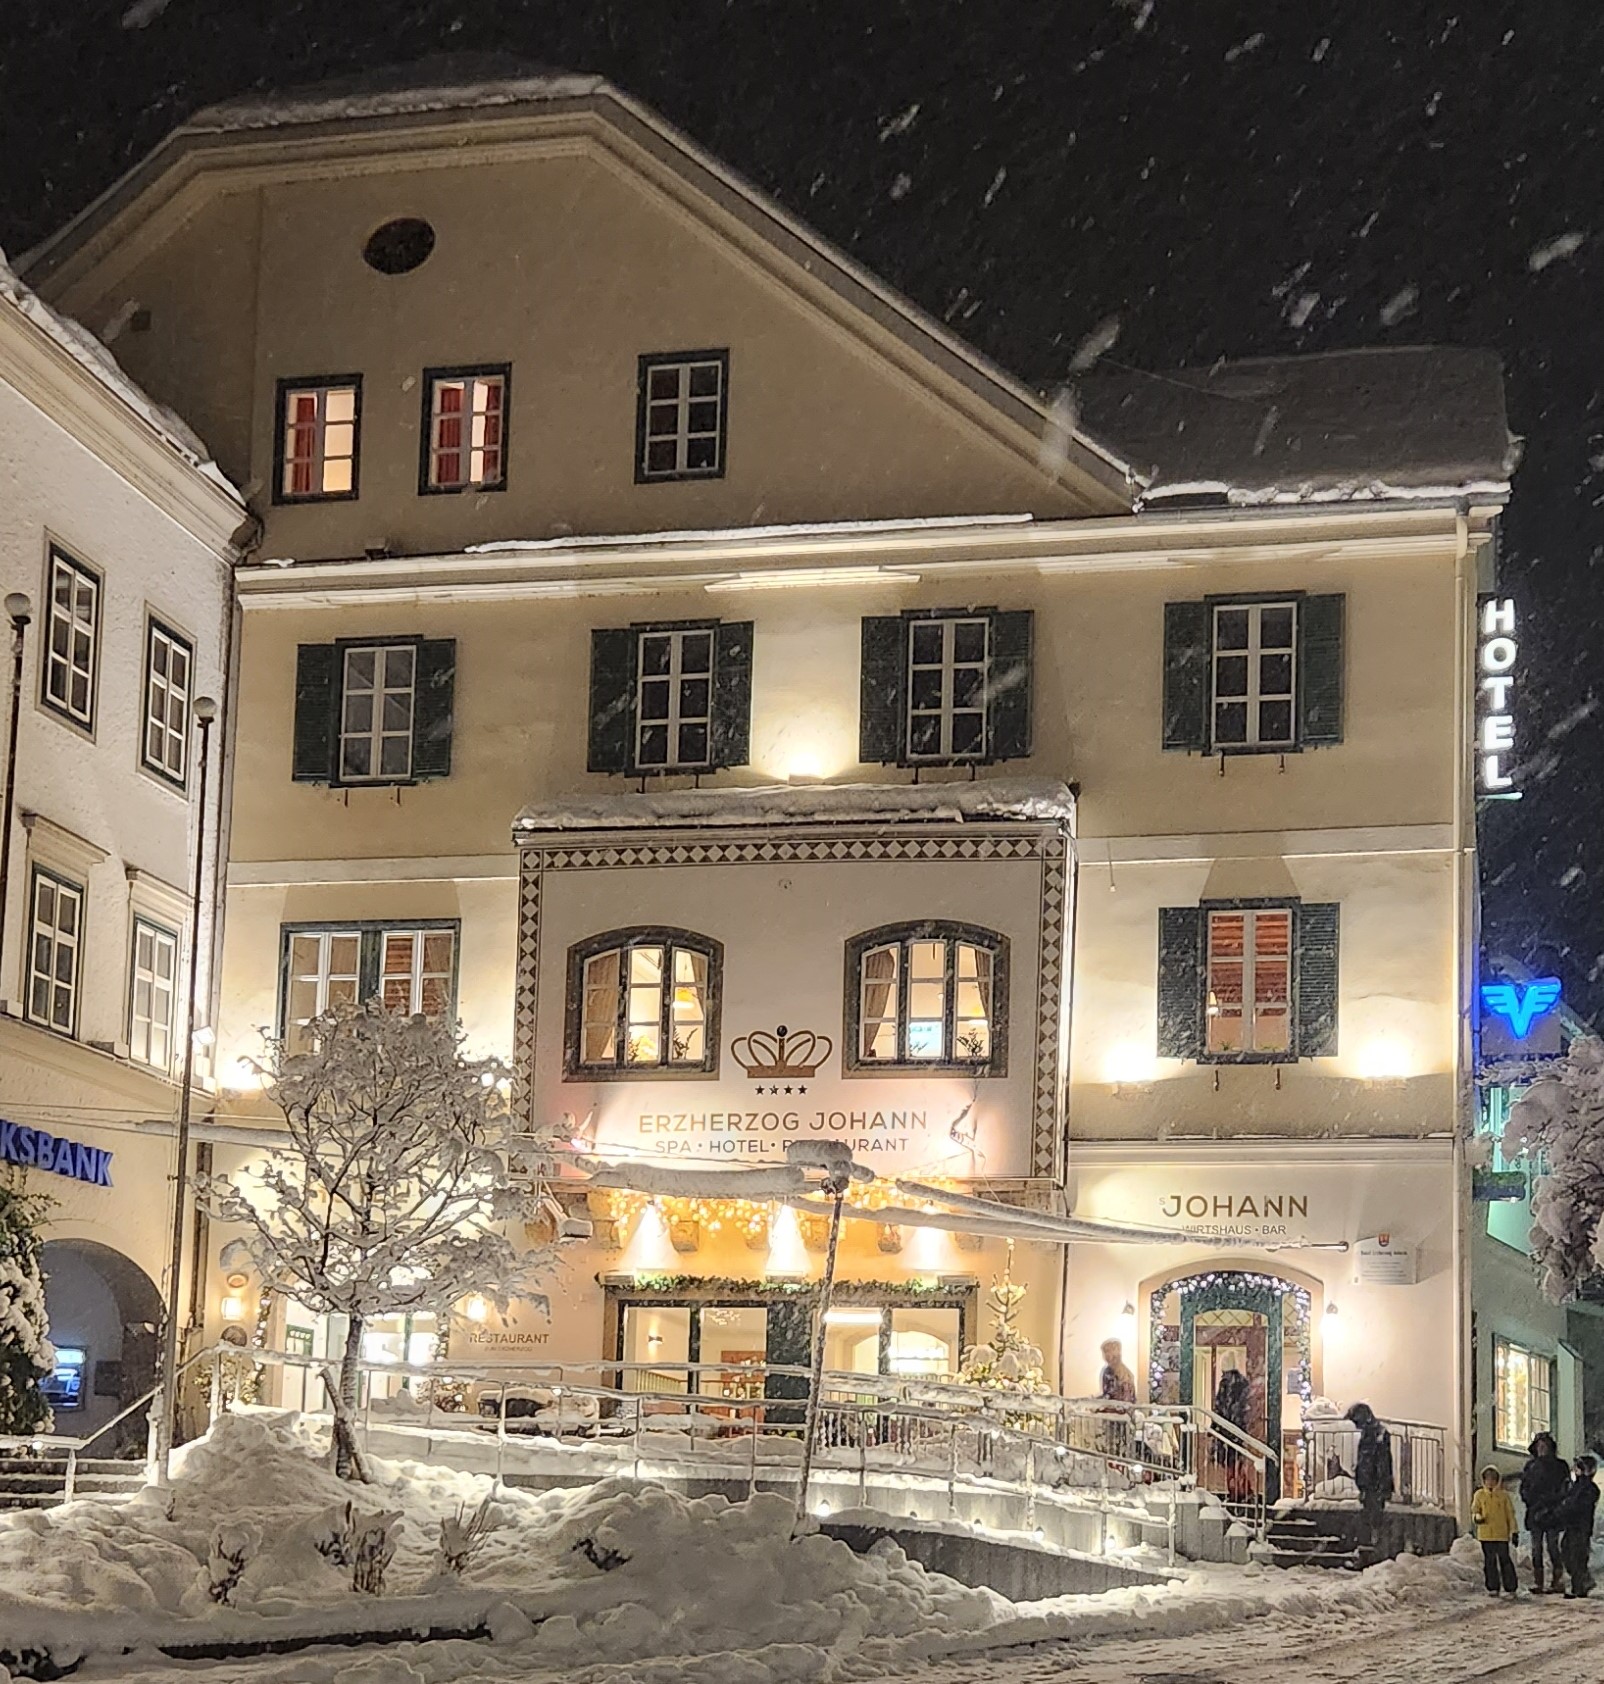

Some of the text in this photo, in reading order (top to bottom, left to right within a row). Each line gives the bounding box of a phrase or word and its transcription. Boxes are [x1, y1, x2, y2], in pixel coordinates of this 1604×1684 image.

[1484, 598, 1516, 788] HOTEL
[639, 1111, 926, 1132] ERZHERZOG JOHANN
[0, 1120, 113, 1187] KSBANK
[656, 1138, 908, 1153] SPA HOTEL RURANT
[1162, 1195, 1307, 1217] JOHANN
[1182, 1225, 1286, 1235] WIRTSHAUS BAR
[469, 1333, 549, 1344] RESTAURANT
